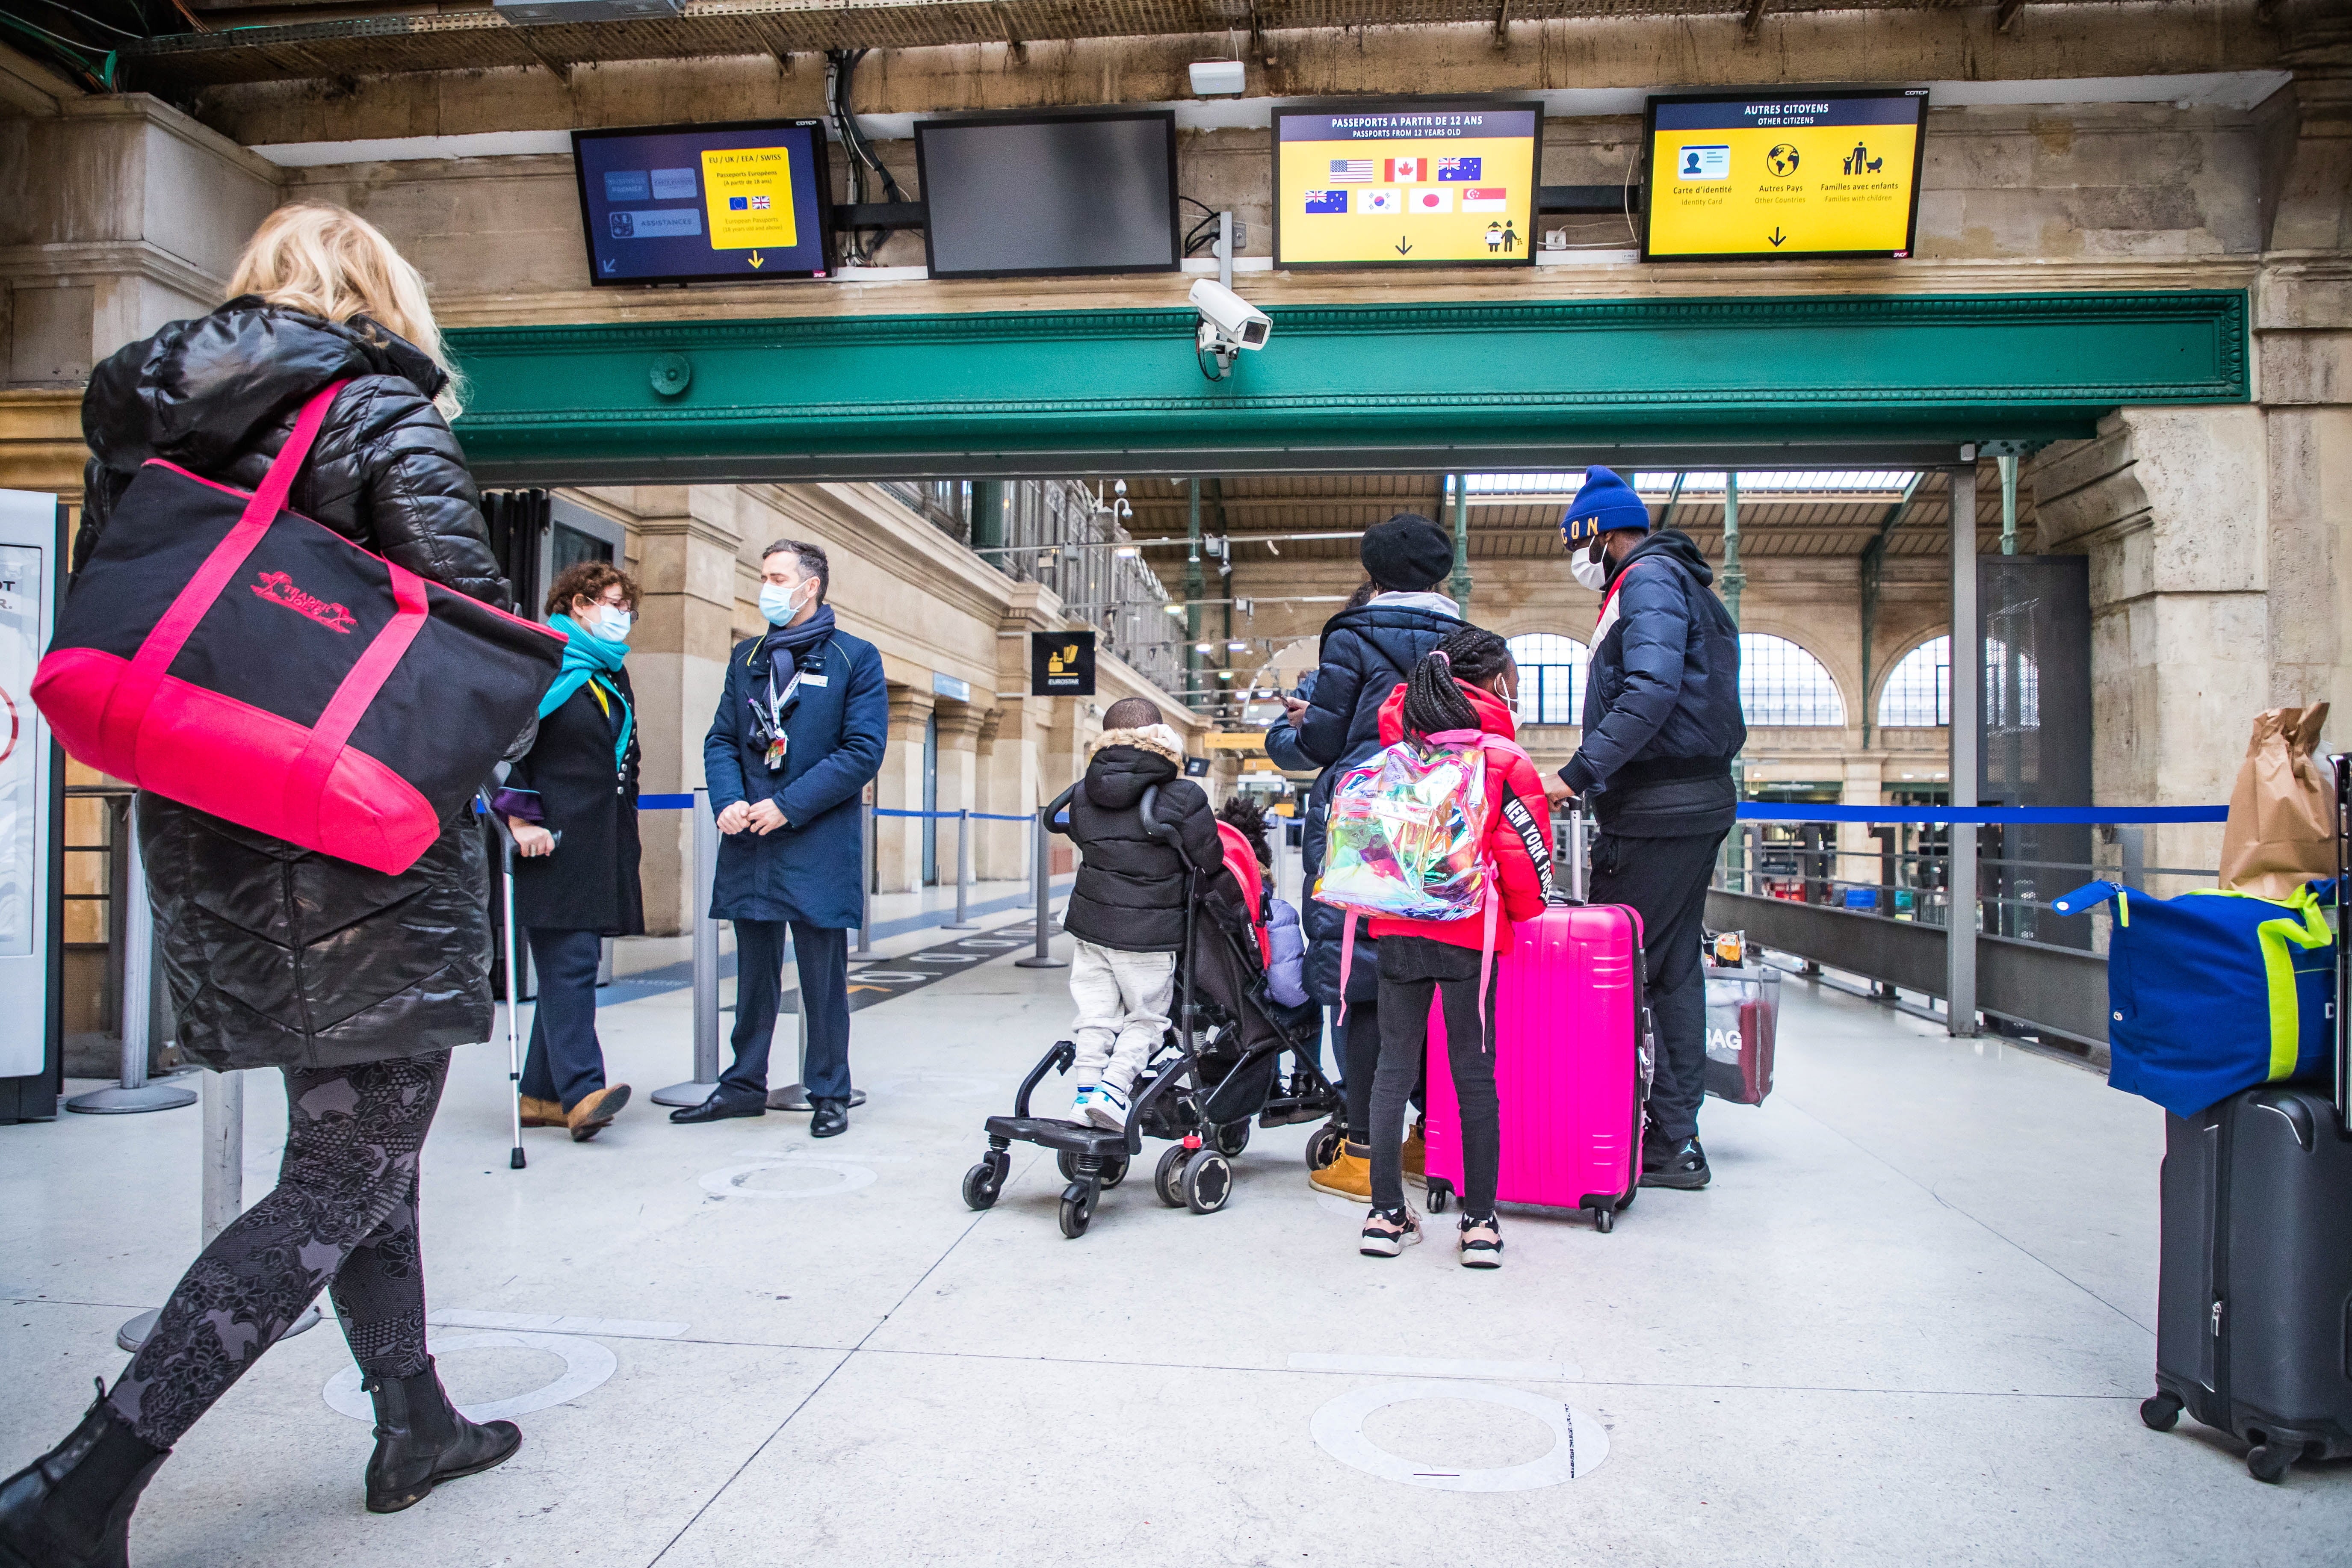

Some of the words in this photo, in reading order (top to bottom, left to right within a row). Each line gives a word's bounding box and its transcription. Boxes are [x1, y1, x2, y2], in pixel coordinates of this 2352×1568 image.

[1744, 105, 1781, 115] AUTRES
[1784, 104, 1829, 114] CITOYENS
[1332, 118, 1388, 127] PASSEPORTS
[1391, 118, 1397, 126] A
[1400, 117, 1432, 126] PARTIR
[1435, 116, 1447, 125] DE
[1450, 116, 1461, 125] 12
[1464, 116, 1482, 125] ANS
[1353, 130, 1390, 138] PASSPORTS
[720, 156, 723, 164] /
[1787, 185, 1803, 193] Pays
[1821, 183, 1850, 191] Familles
[1560, 517, 1598, 544] CON
[284, 585, 331, 613] TRADER
[1504, 799, 1531, 827] NEW
[1522, 824, 1548, 863] YORK
